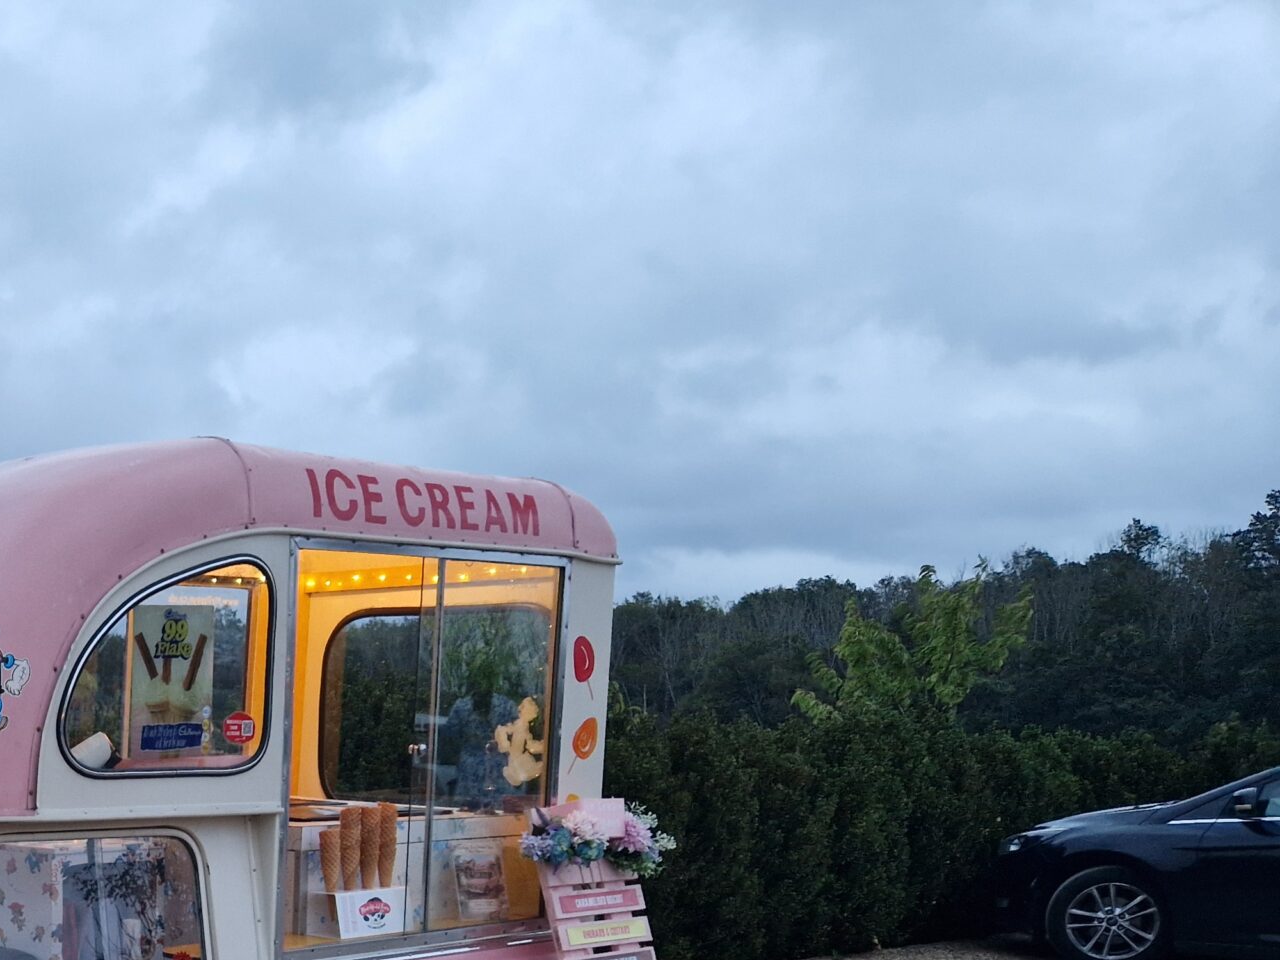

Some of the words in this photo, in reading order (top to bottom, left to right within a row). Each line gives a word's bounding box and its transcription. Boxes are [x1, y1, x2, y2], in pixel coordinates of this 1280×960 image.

[305, 468, 387, 525] ICE
[395, 478, 539, 536] CREAM
[161, 619, 189, 642] 99
[154, 640, 193, 660] Flake
